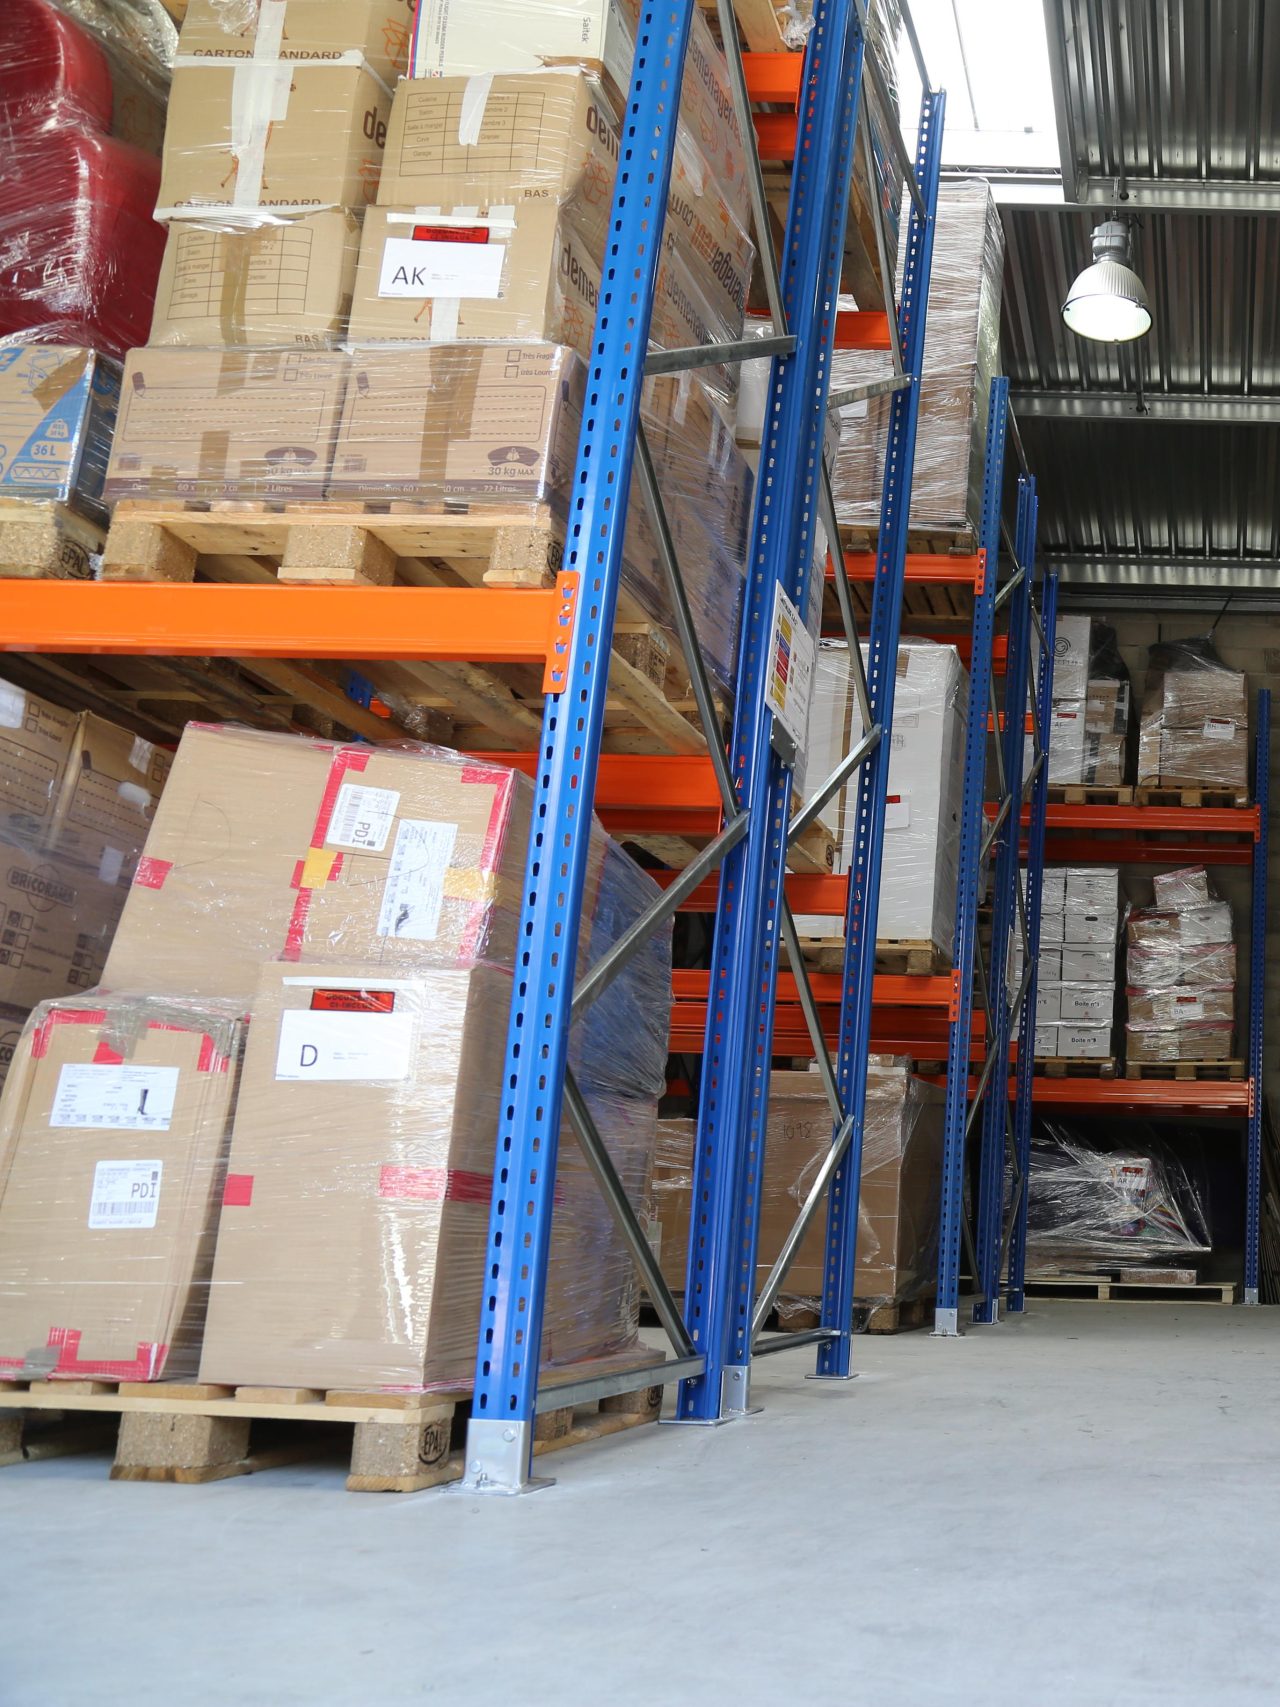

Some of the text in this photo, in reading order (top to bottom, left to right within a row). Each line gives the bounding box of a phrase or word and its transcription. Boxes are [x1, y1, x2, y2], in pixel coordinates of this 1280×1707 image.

[581, 16, 591, 43] Saitek
[279, 50, 342, 60] ANDARD
[524, 189, 549, 198] BAS
[391, 265, 427, 286] AK
[295, 334, 319, 343] BAS
[34, 444, 56, 456] 36 L
[488, 467, 501, 476] 30
[503, 466, 516, 478] kg
[352, 821, 371, 846] PDI
[300, 1044, 318, 1067] D
[131, 1182, 157, 1199] PDI
